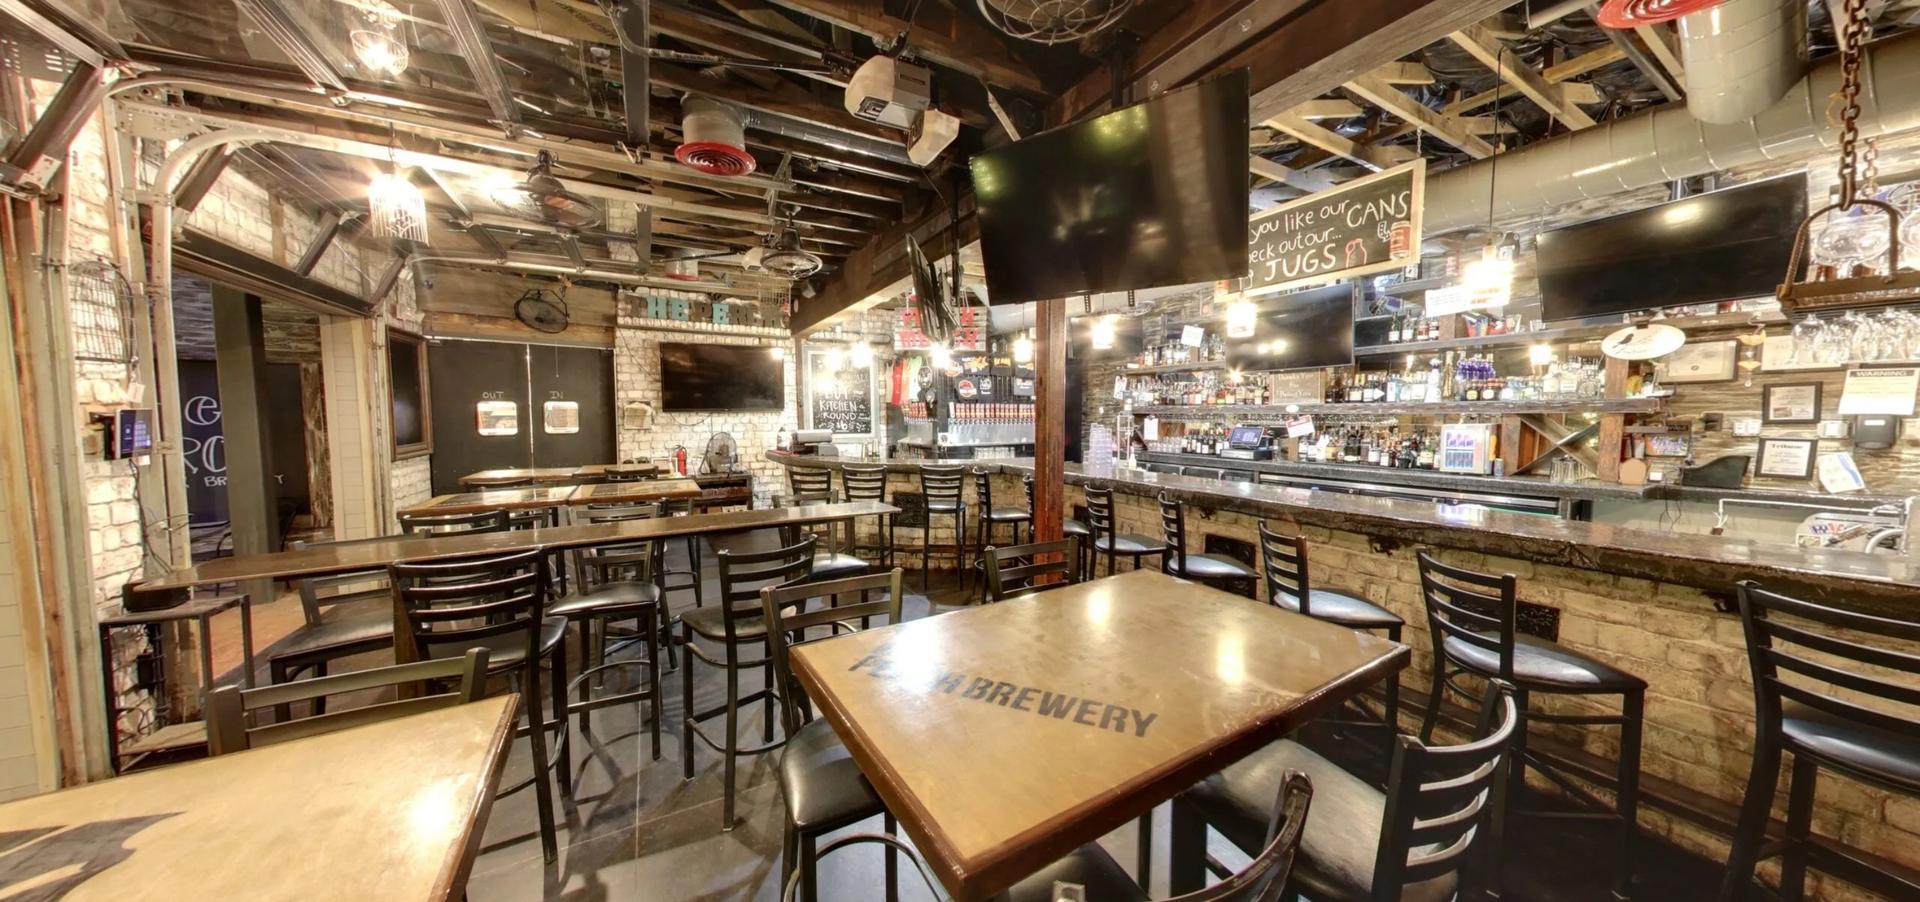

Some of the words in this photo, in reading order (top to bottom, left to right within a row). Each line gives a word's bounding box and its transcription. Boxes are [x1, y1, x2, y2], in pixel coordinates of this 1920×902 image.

[1249, 219, 1279, 245] you
[1284, 213, 1314, 234] like
[1319, 199, 1350, 220] our
[1346, 190, 1411, 229] CANS
[1264, 242, 1337, 282] JUGS
[1857, 370, 1908, 378] WARNING
[481, 391, 505, 399] OUT
[549, 390, 564, 399] IN
[819, 399, 857, 411] KITCHEN
[822, 412, 857, 420] ROUND
[961, 676, 1158, 738] BREWERY
